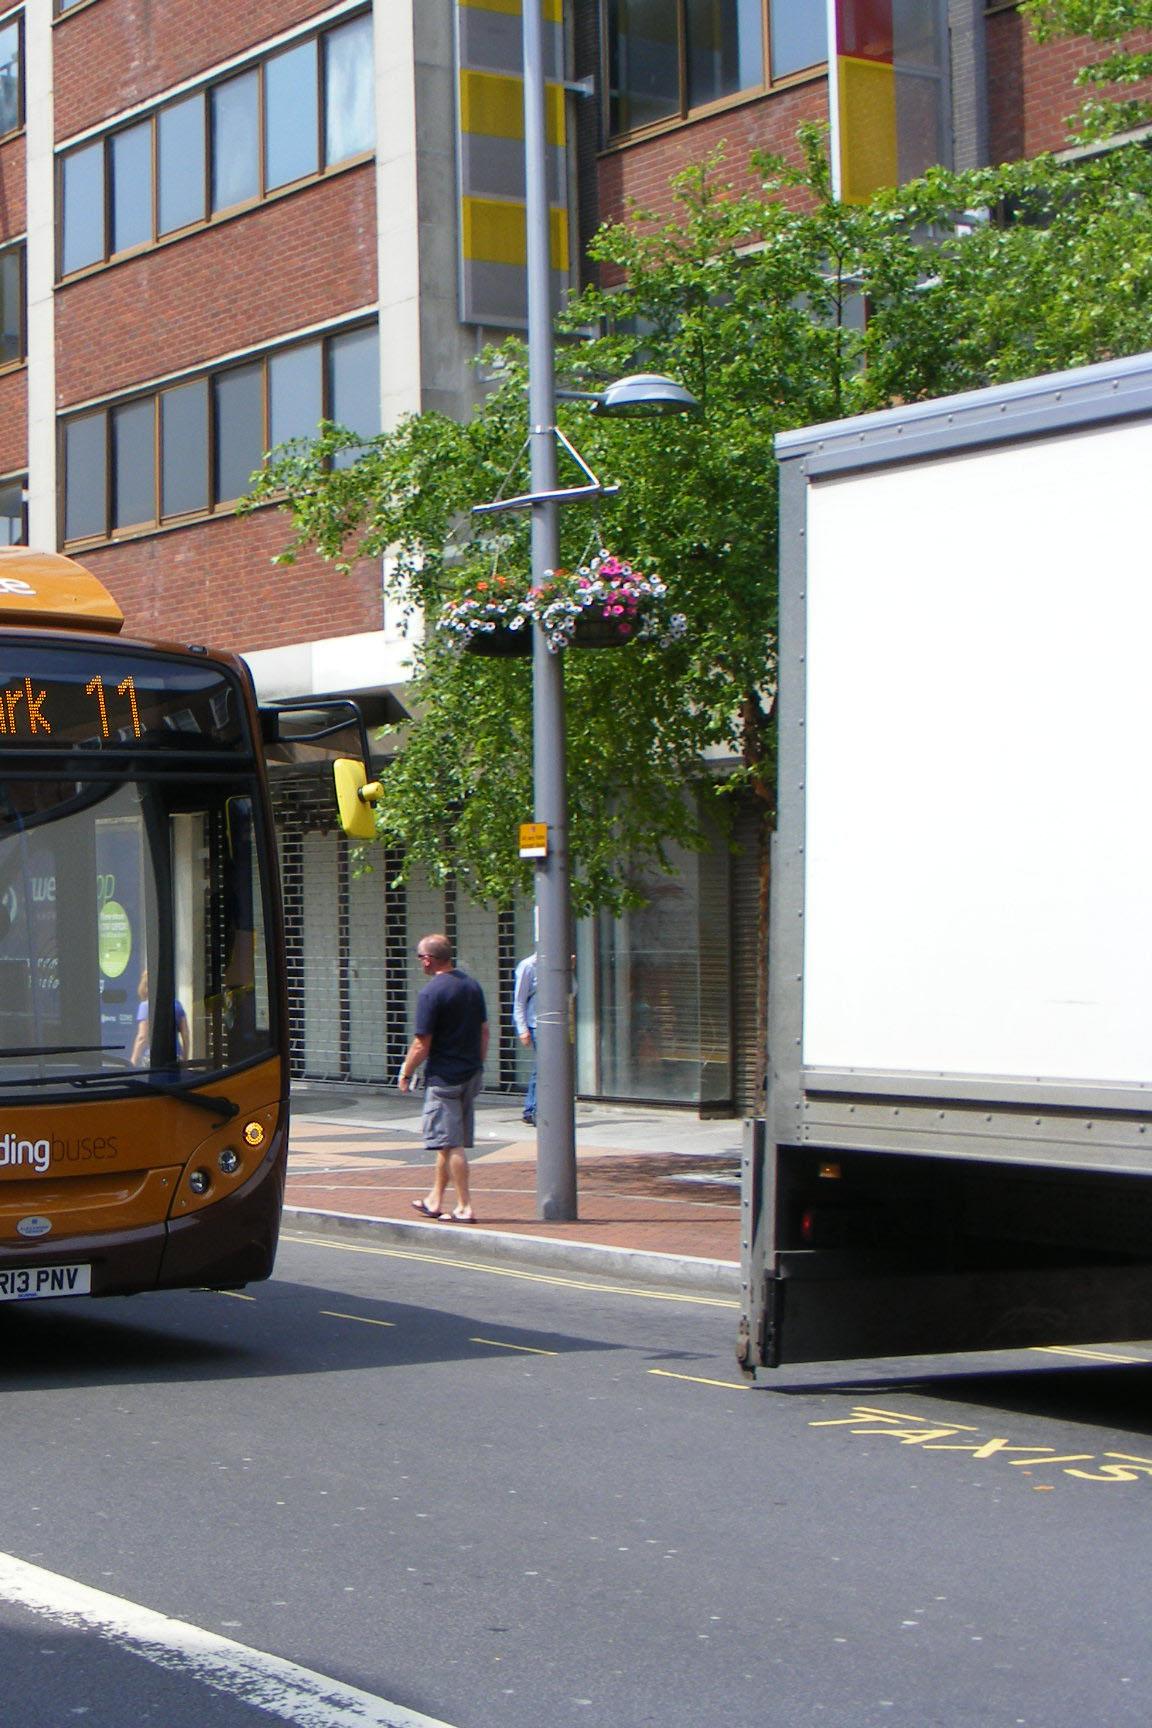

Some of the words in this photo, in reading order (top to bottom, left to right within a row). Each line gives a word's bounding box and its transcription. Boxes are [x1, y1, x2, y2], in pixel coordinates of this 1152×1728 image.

[85, 675, 141, 738] 11
[36, 1267, 79, 1292] PNV
[809, 1411, 1152, 1481] TAXIS
